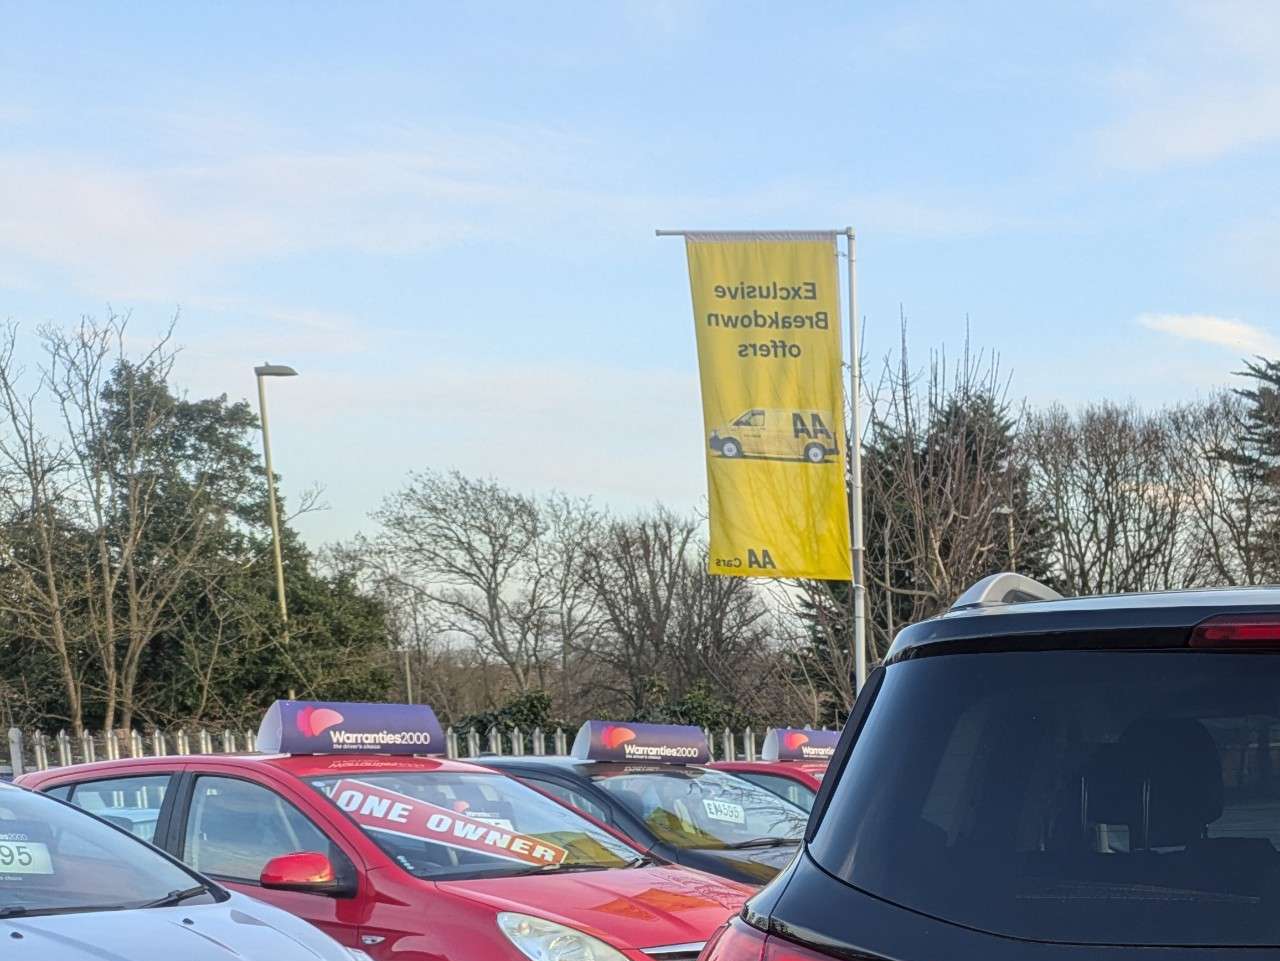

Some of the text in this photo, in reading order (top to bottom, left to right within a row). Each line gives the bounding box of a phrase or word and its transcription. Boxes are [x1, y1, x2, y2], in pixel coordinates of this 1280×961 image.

[329, 730, 431, 745] Warranties2000
[623, 743, 699, 758] Warranties2000
[336, 790, 557, 863] ONE OWNER
